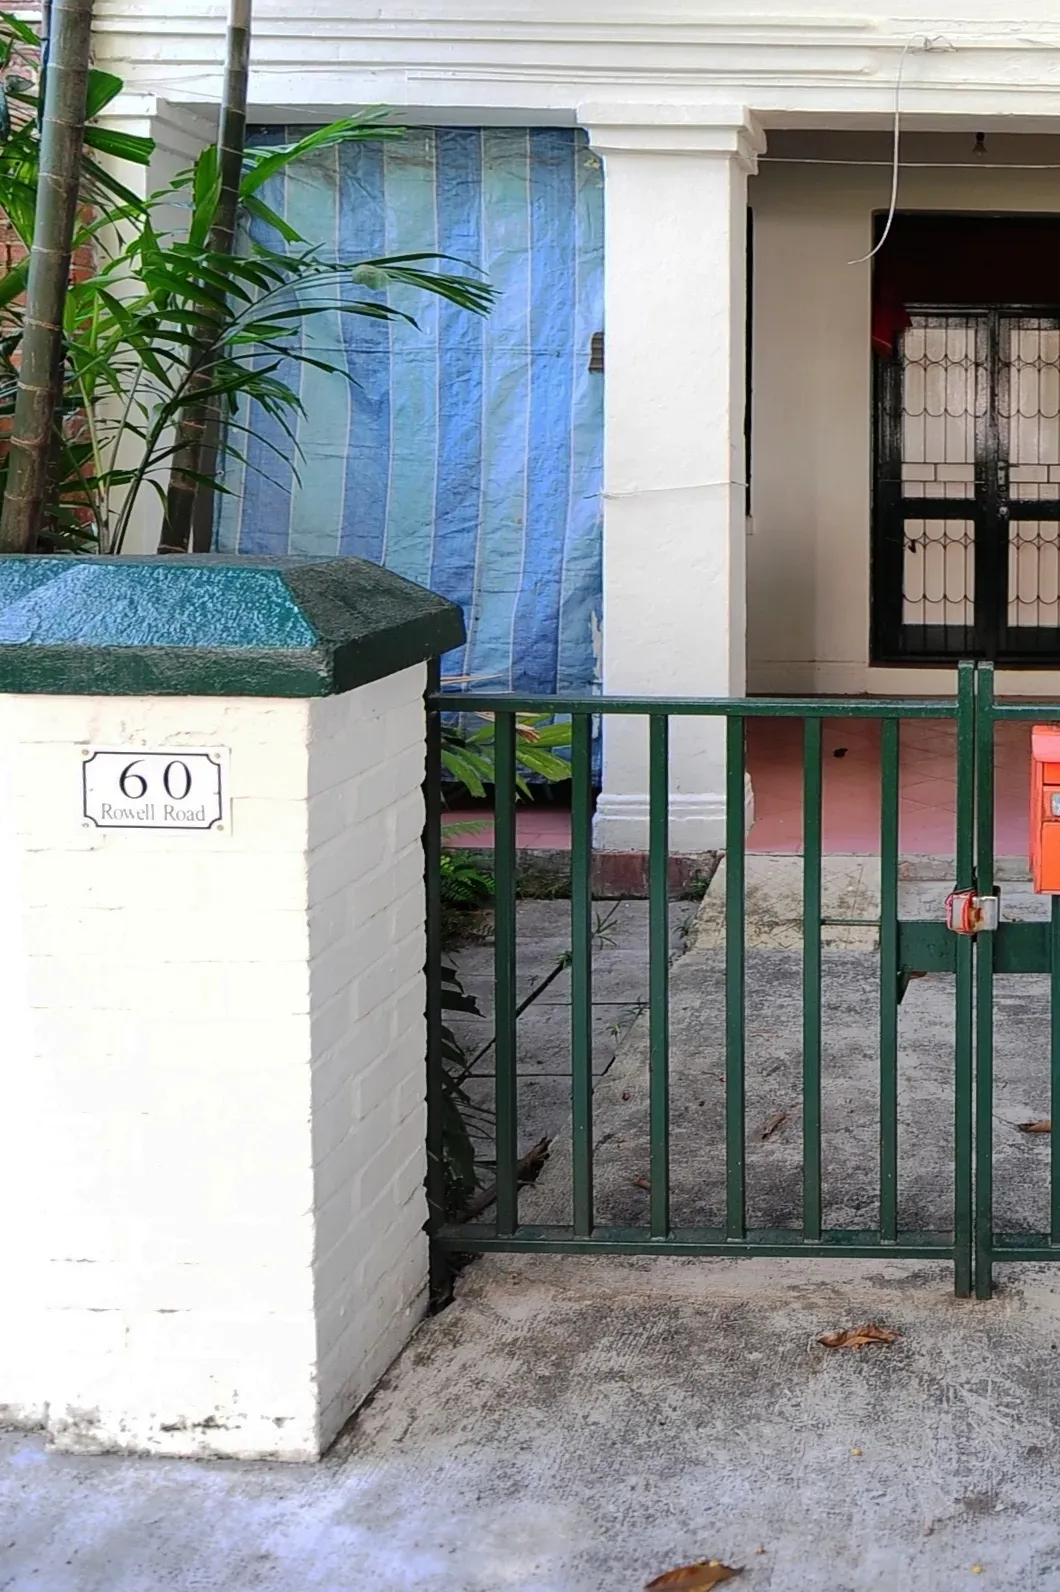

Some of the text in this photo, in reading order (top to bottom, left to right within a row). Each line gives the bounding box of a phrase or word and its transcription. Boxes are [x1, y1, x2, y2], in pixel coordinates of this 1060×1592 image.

[119, 759, 192, 800] 60
[101, 803, 206, 821] Rowell Road
